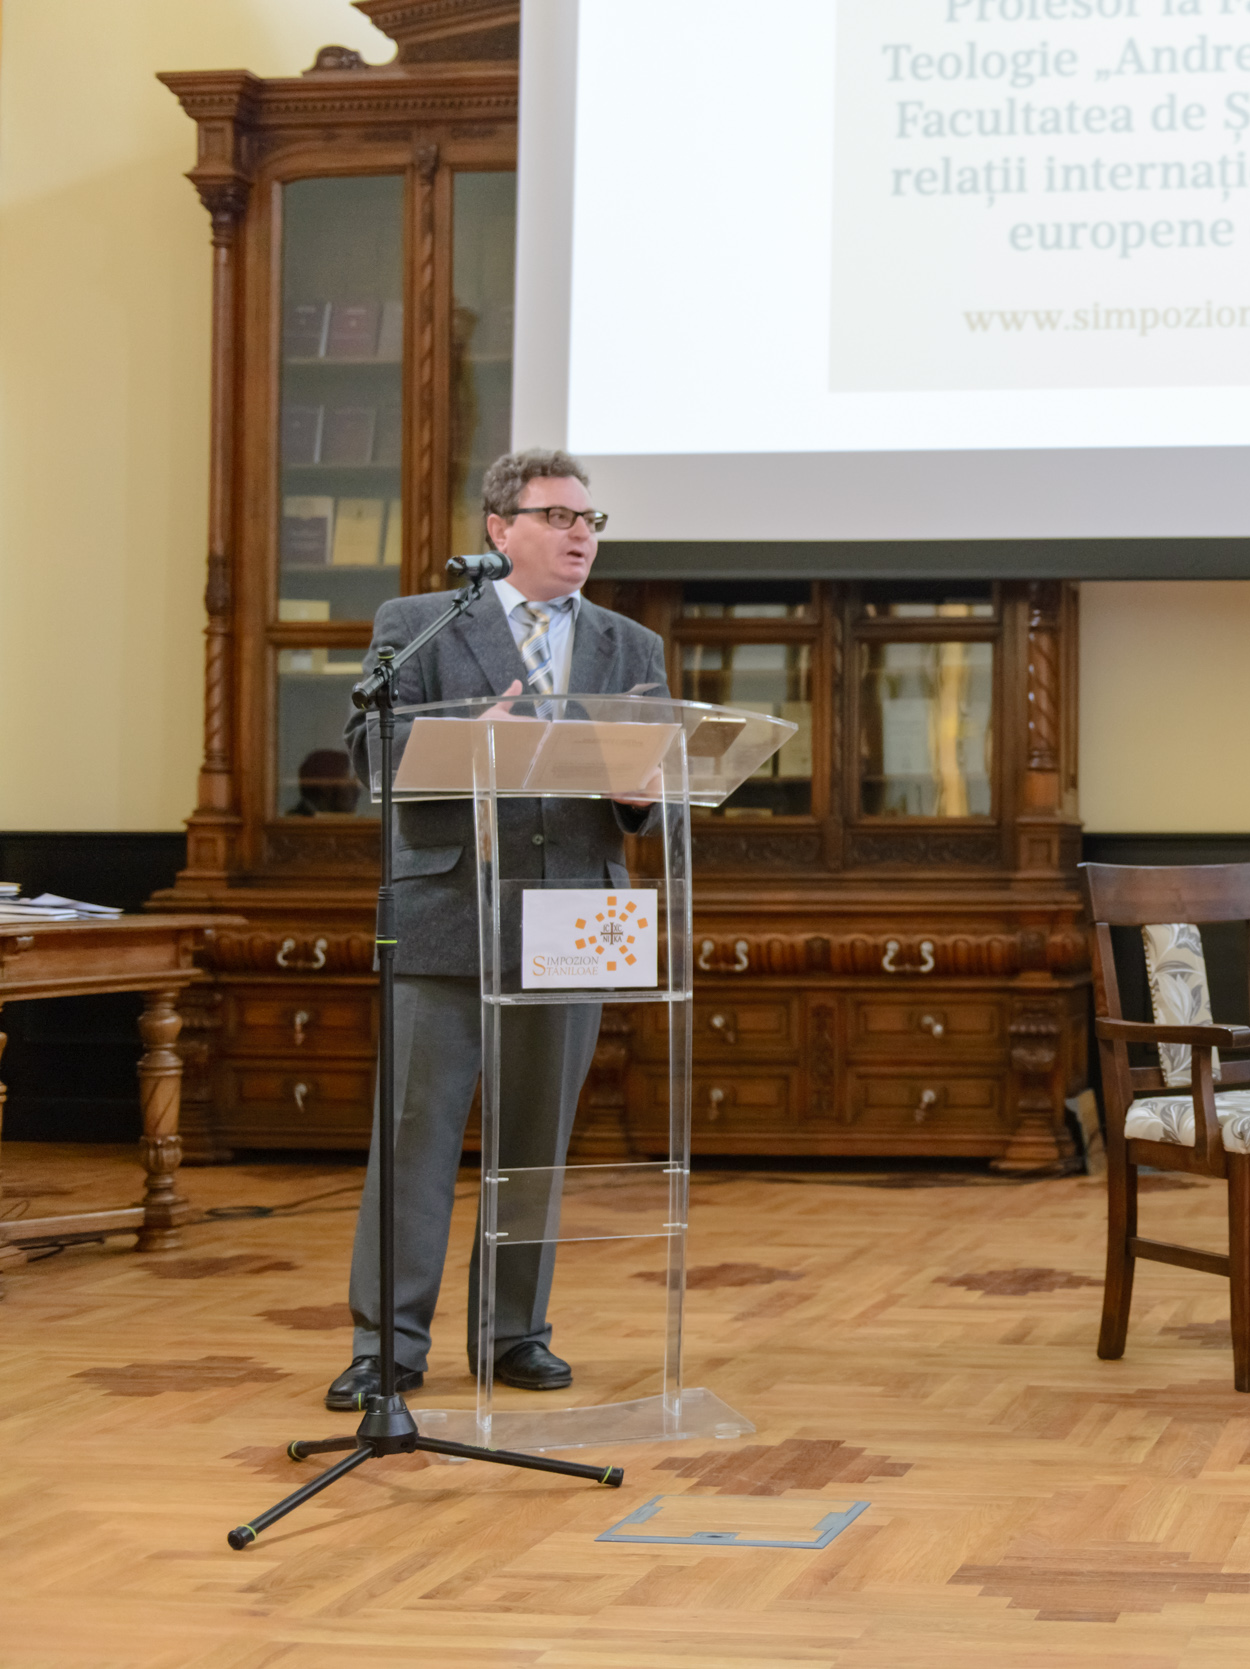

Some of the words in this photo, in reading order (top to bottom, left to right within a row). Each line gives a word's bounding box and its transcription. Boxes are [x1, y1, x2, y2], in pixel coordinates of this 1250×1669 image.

[881, 40, 1078, 89] Teologie
[896, 96, 1134, 139] Facultatea
[1150, 92, 1206, 132] de
[891, 156, 1027, 208] relații
[1008, 218, 1234, 259] europene
